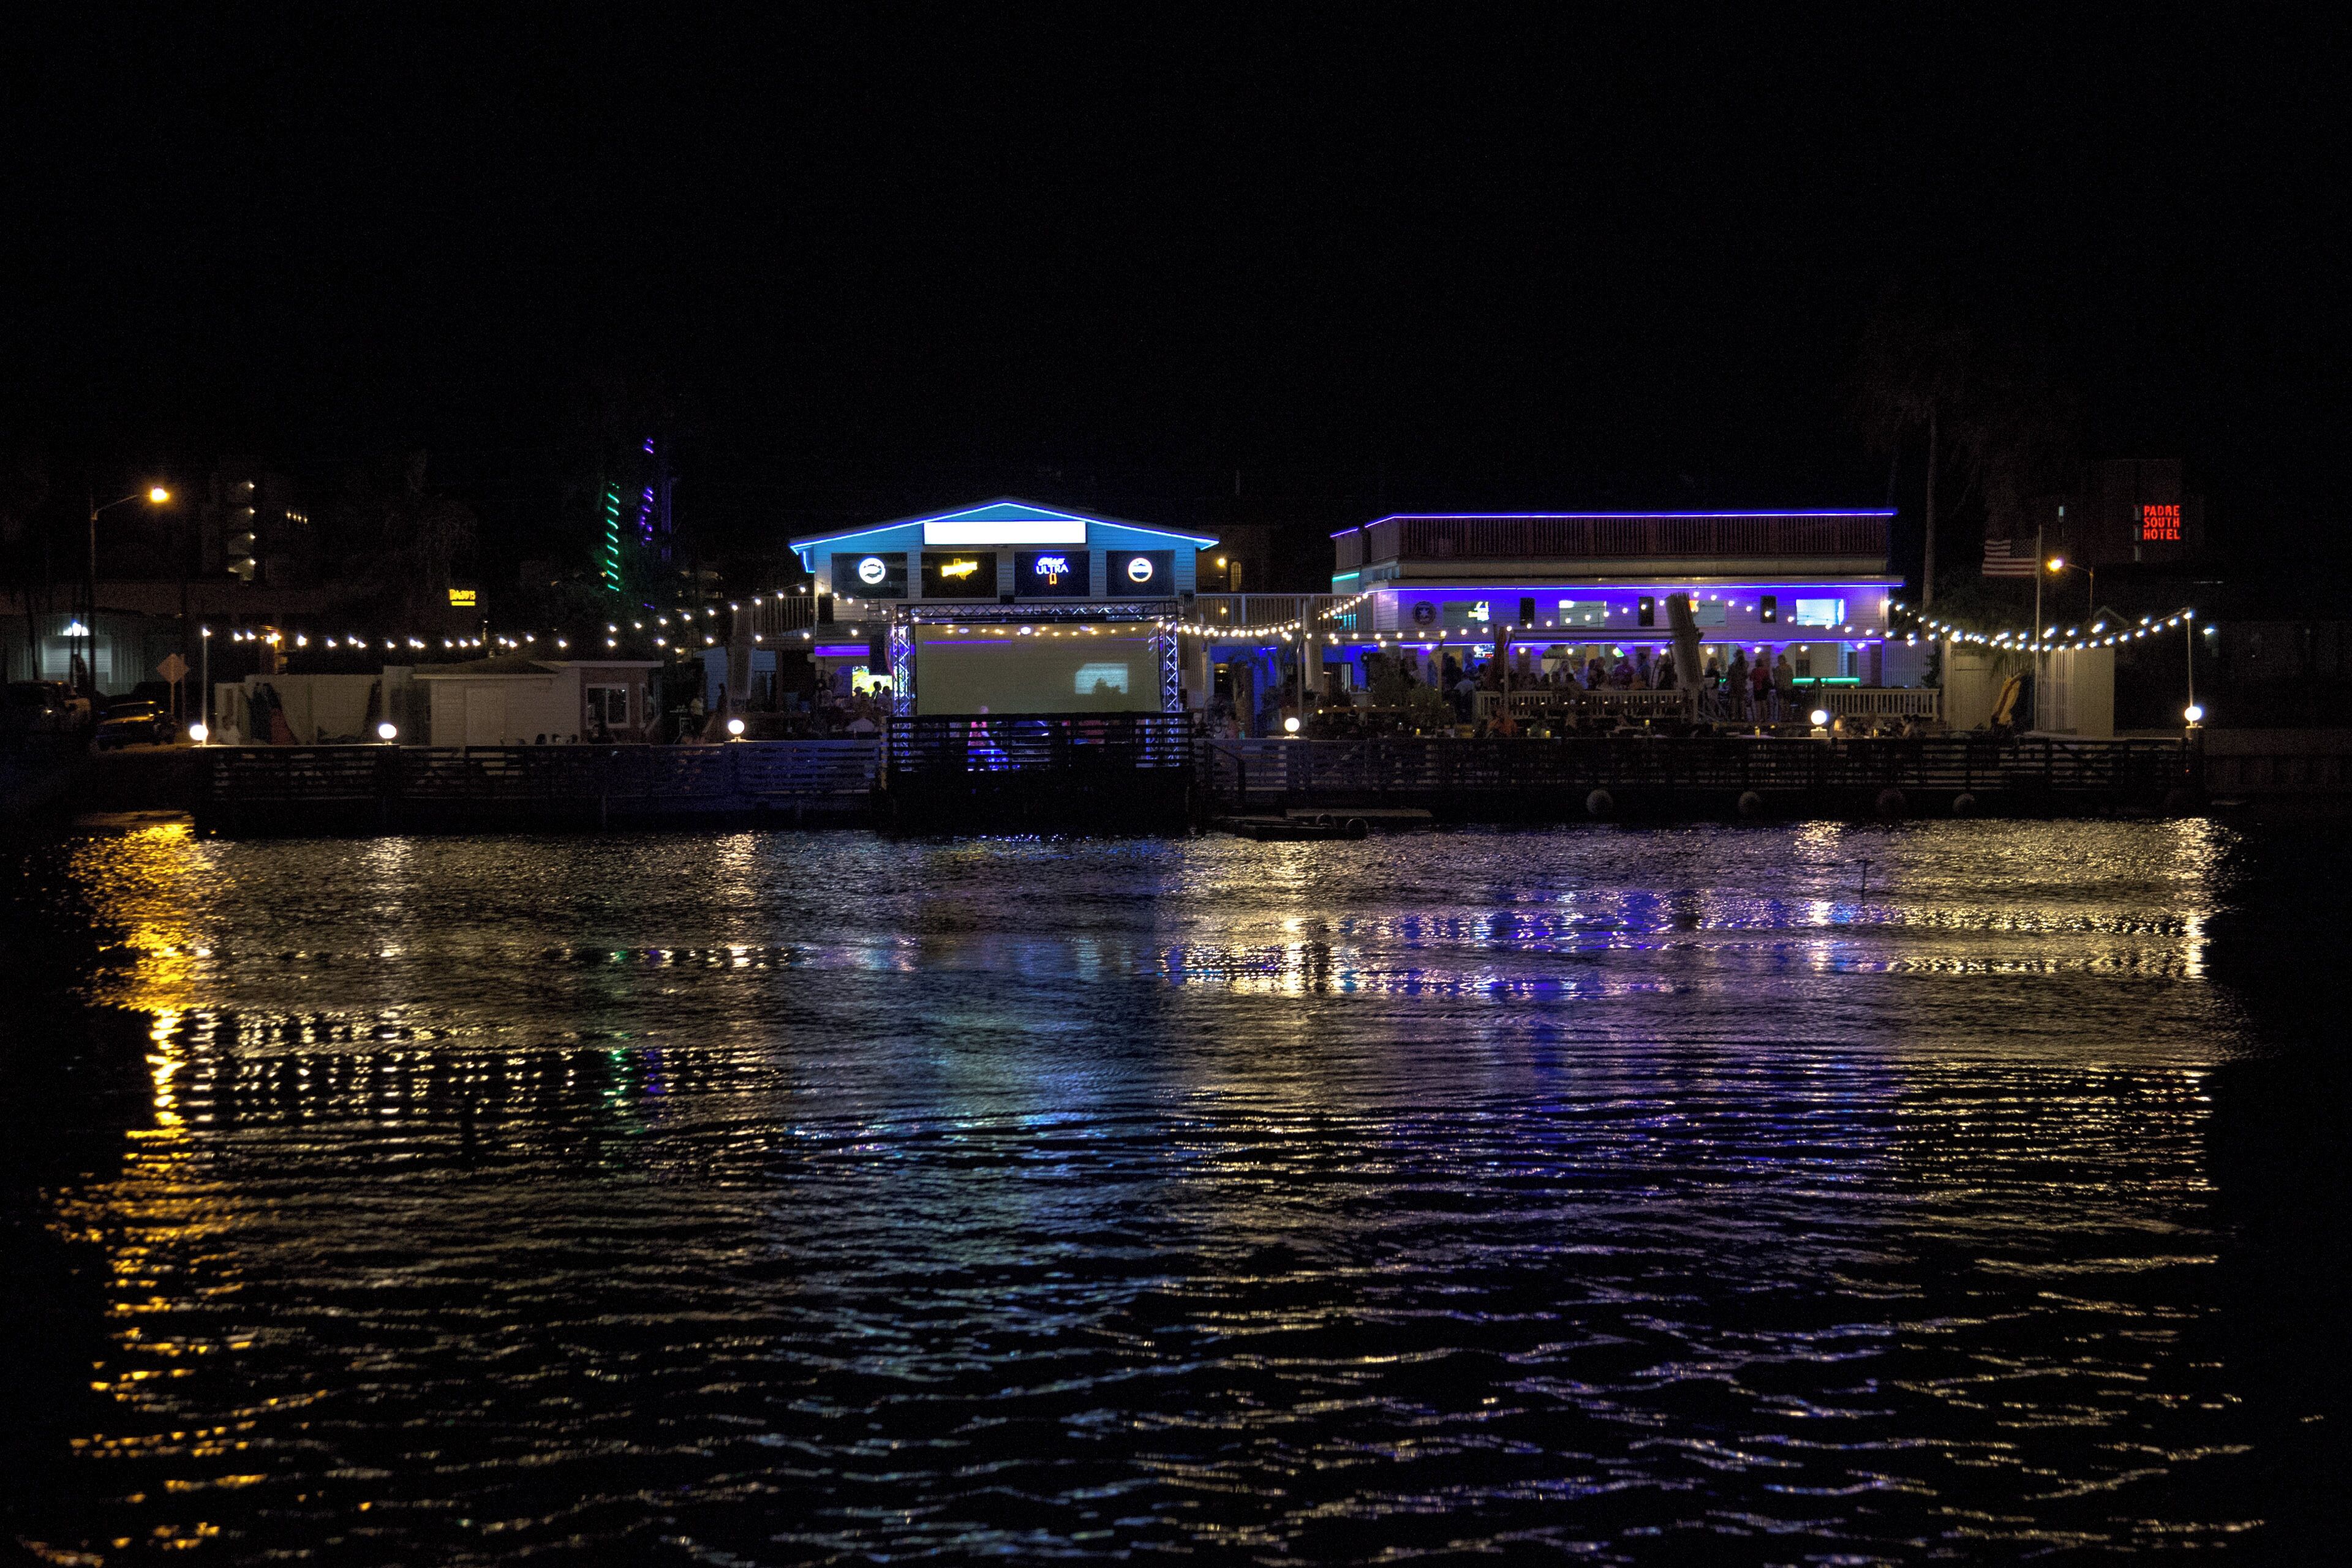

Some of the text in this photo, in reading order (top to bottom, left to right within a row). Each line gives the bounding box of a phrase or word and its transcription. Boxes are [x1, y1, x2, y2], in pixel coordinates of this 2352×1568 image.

[2144, 505, 2180, 516] PADRE
[2143, 517, 2180, 528] SOUTH
[2143, 529, 2180, 540] HOTEL
[1036, 564, 1069, 575] ULTRA
